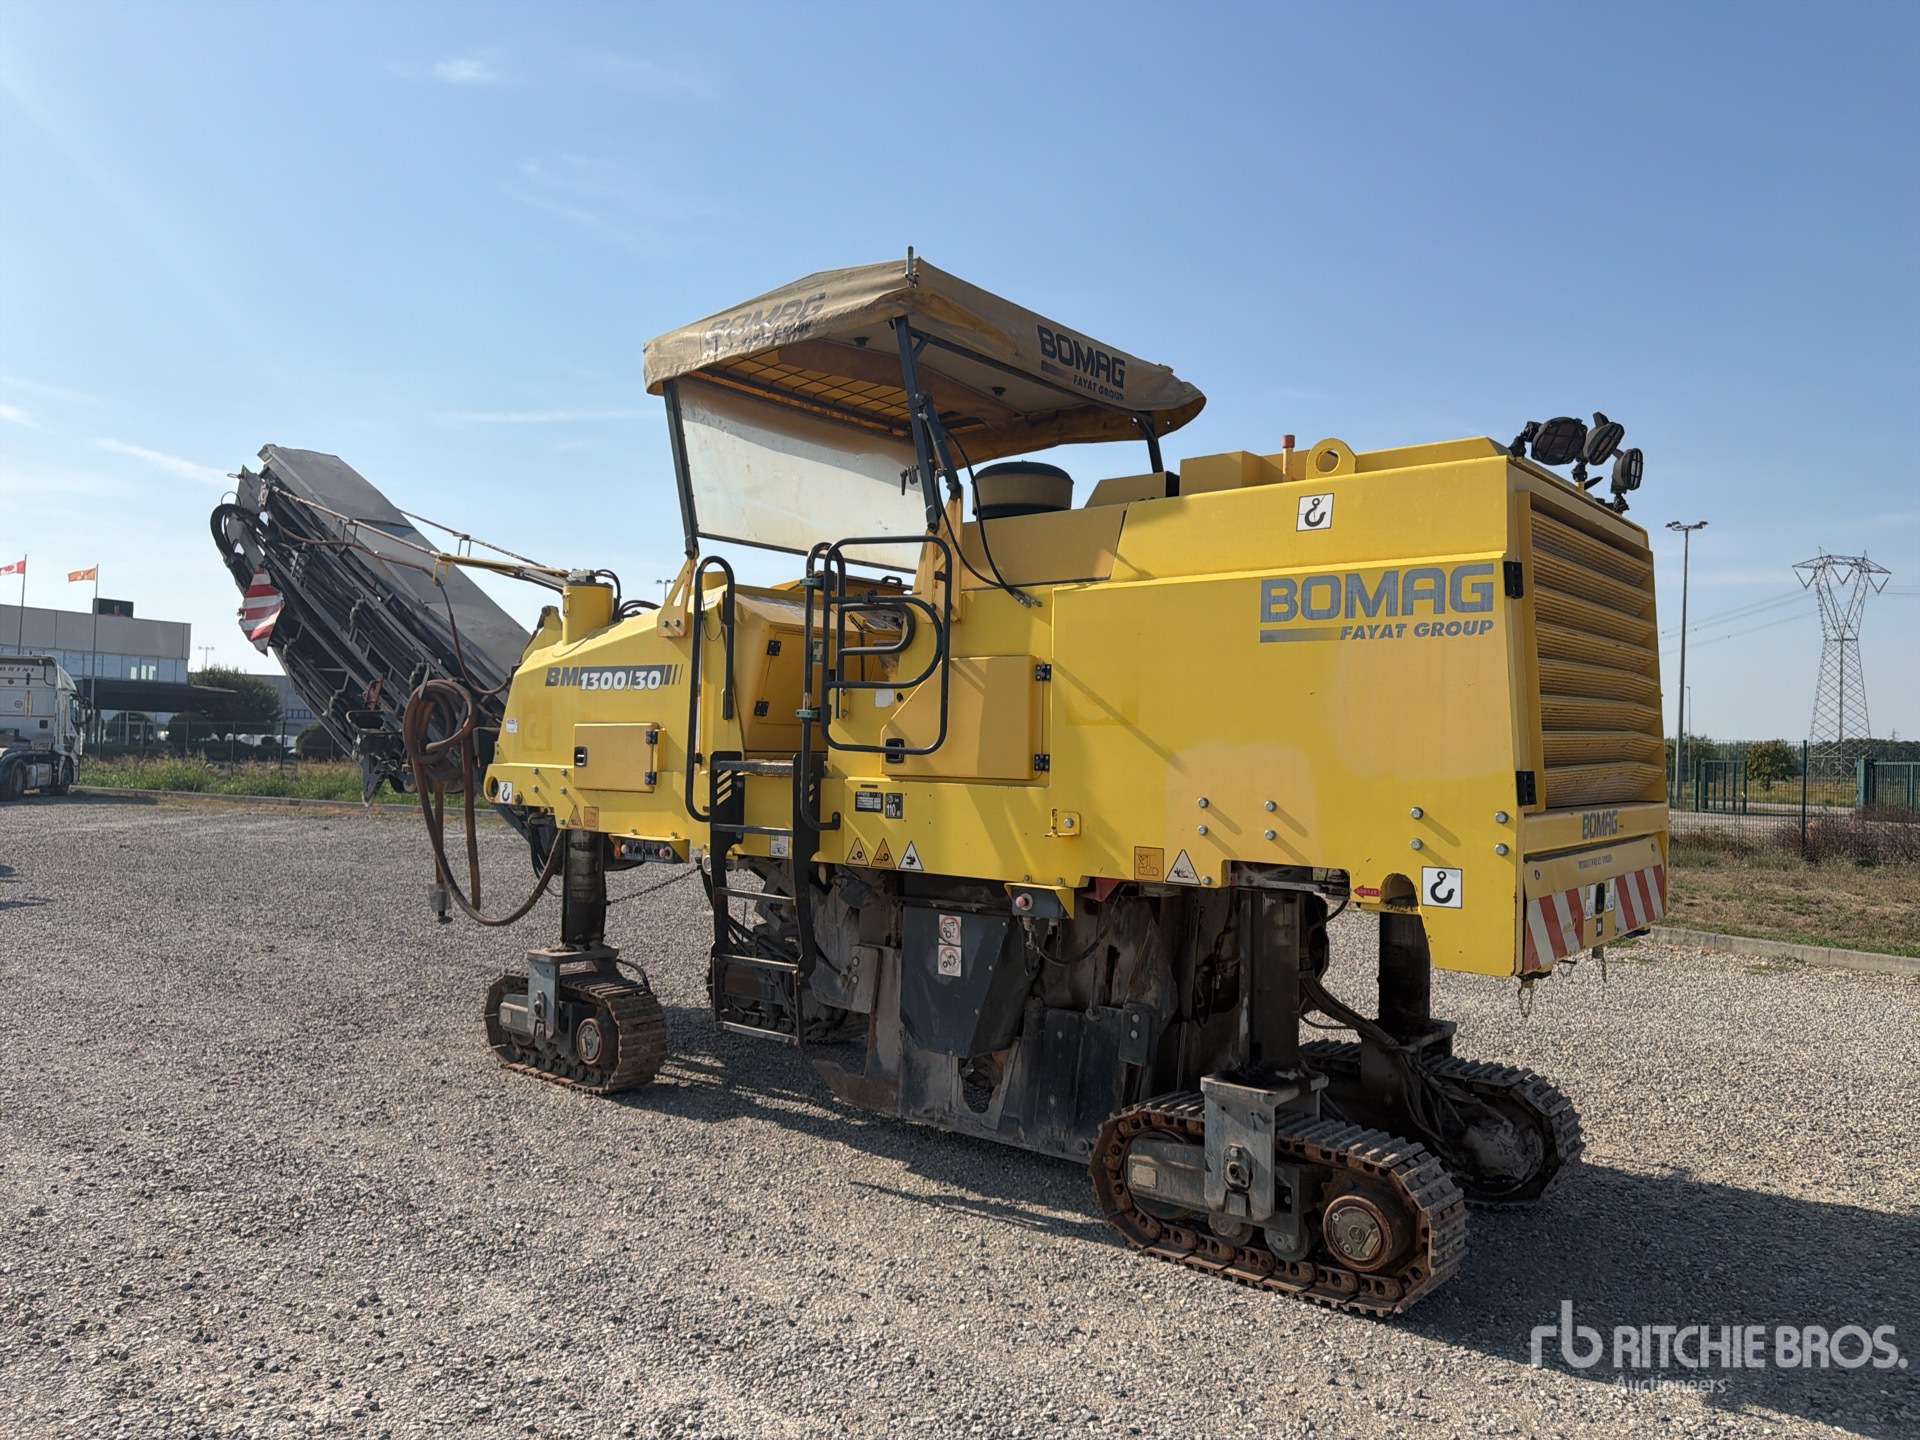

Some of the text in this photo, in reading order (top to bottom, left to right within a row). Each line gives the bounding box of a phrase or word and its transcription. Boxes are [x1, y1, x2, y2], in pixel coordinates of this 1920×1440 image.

[1037, 325, 1126, 389] BOMAG
[1073, 375, 1124, 400] FAYAT GROUP
[1260, 563, 1494, 623] BOMAG
[1340, 619, 1494, 640] FAYAT GROUP
[1582, 810, 1618, 840] BOMAG
